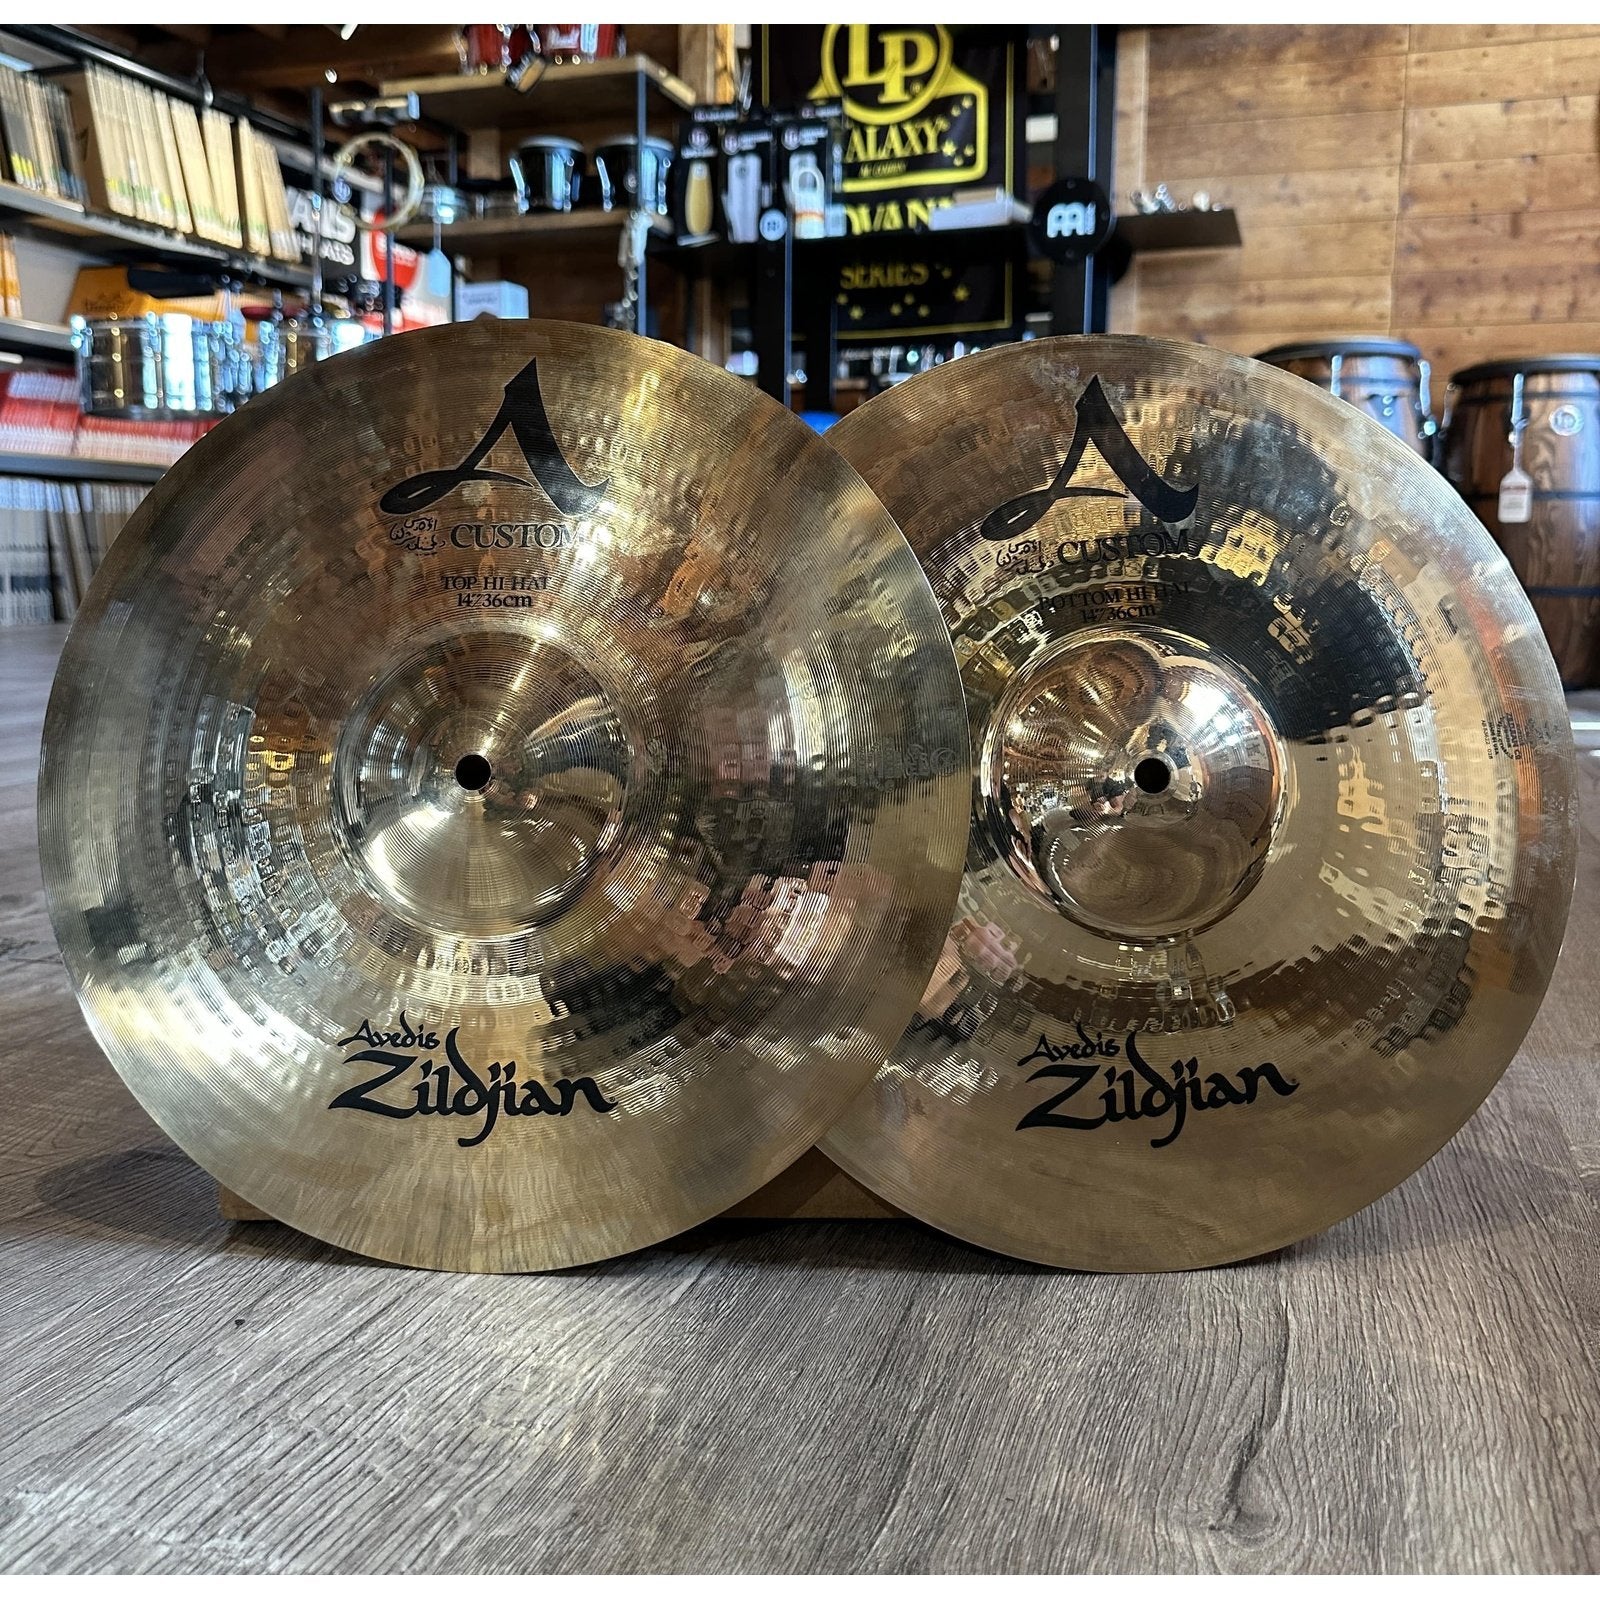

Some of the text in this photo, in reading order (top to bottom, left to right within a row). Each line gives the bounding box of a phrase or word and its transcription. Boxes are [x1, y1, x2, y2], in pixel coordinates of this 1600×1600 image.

[844, 118, 942, 164] ALAXY
[379, 357, 612, 516] A
[979, 374, 1199, 541] A
[450, 523, 579, 549] CUSTOM
[1057, 529, 1191, 565] CUSTOM
[441, 575, 552, 590] TOP HI HAT
[1040, 580, 1191, 611] BOTTOM HI HAT
[337, 1009, 441, 1049] Avedis
[1016, 1021, 1121, 1067] Avedis
[327, 1026, 620, 1148] Zildjian
[1015, 1030, 1300, 1149] Zildjian
